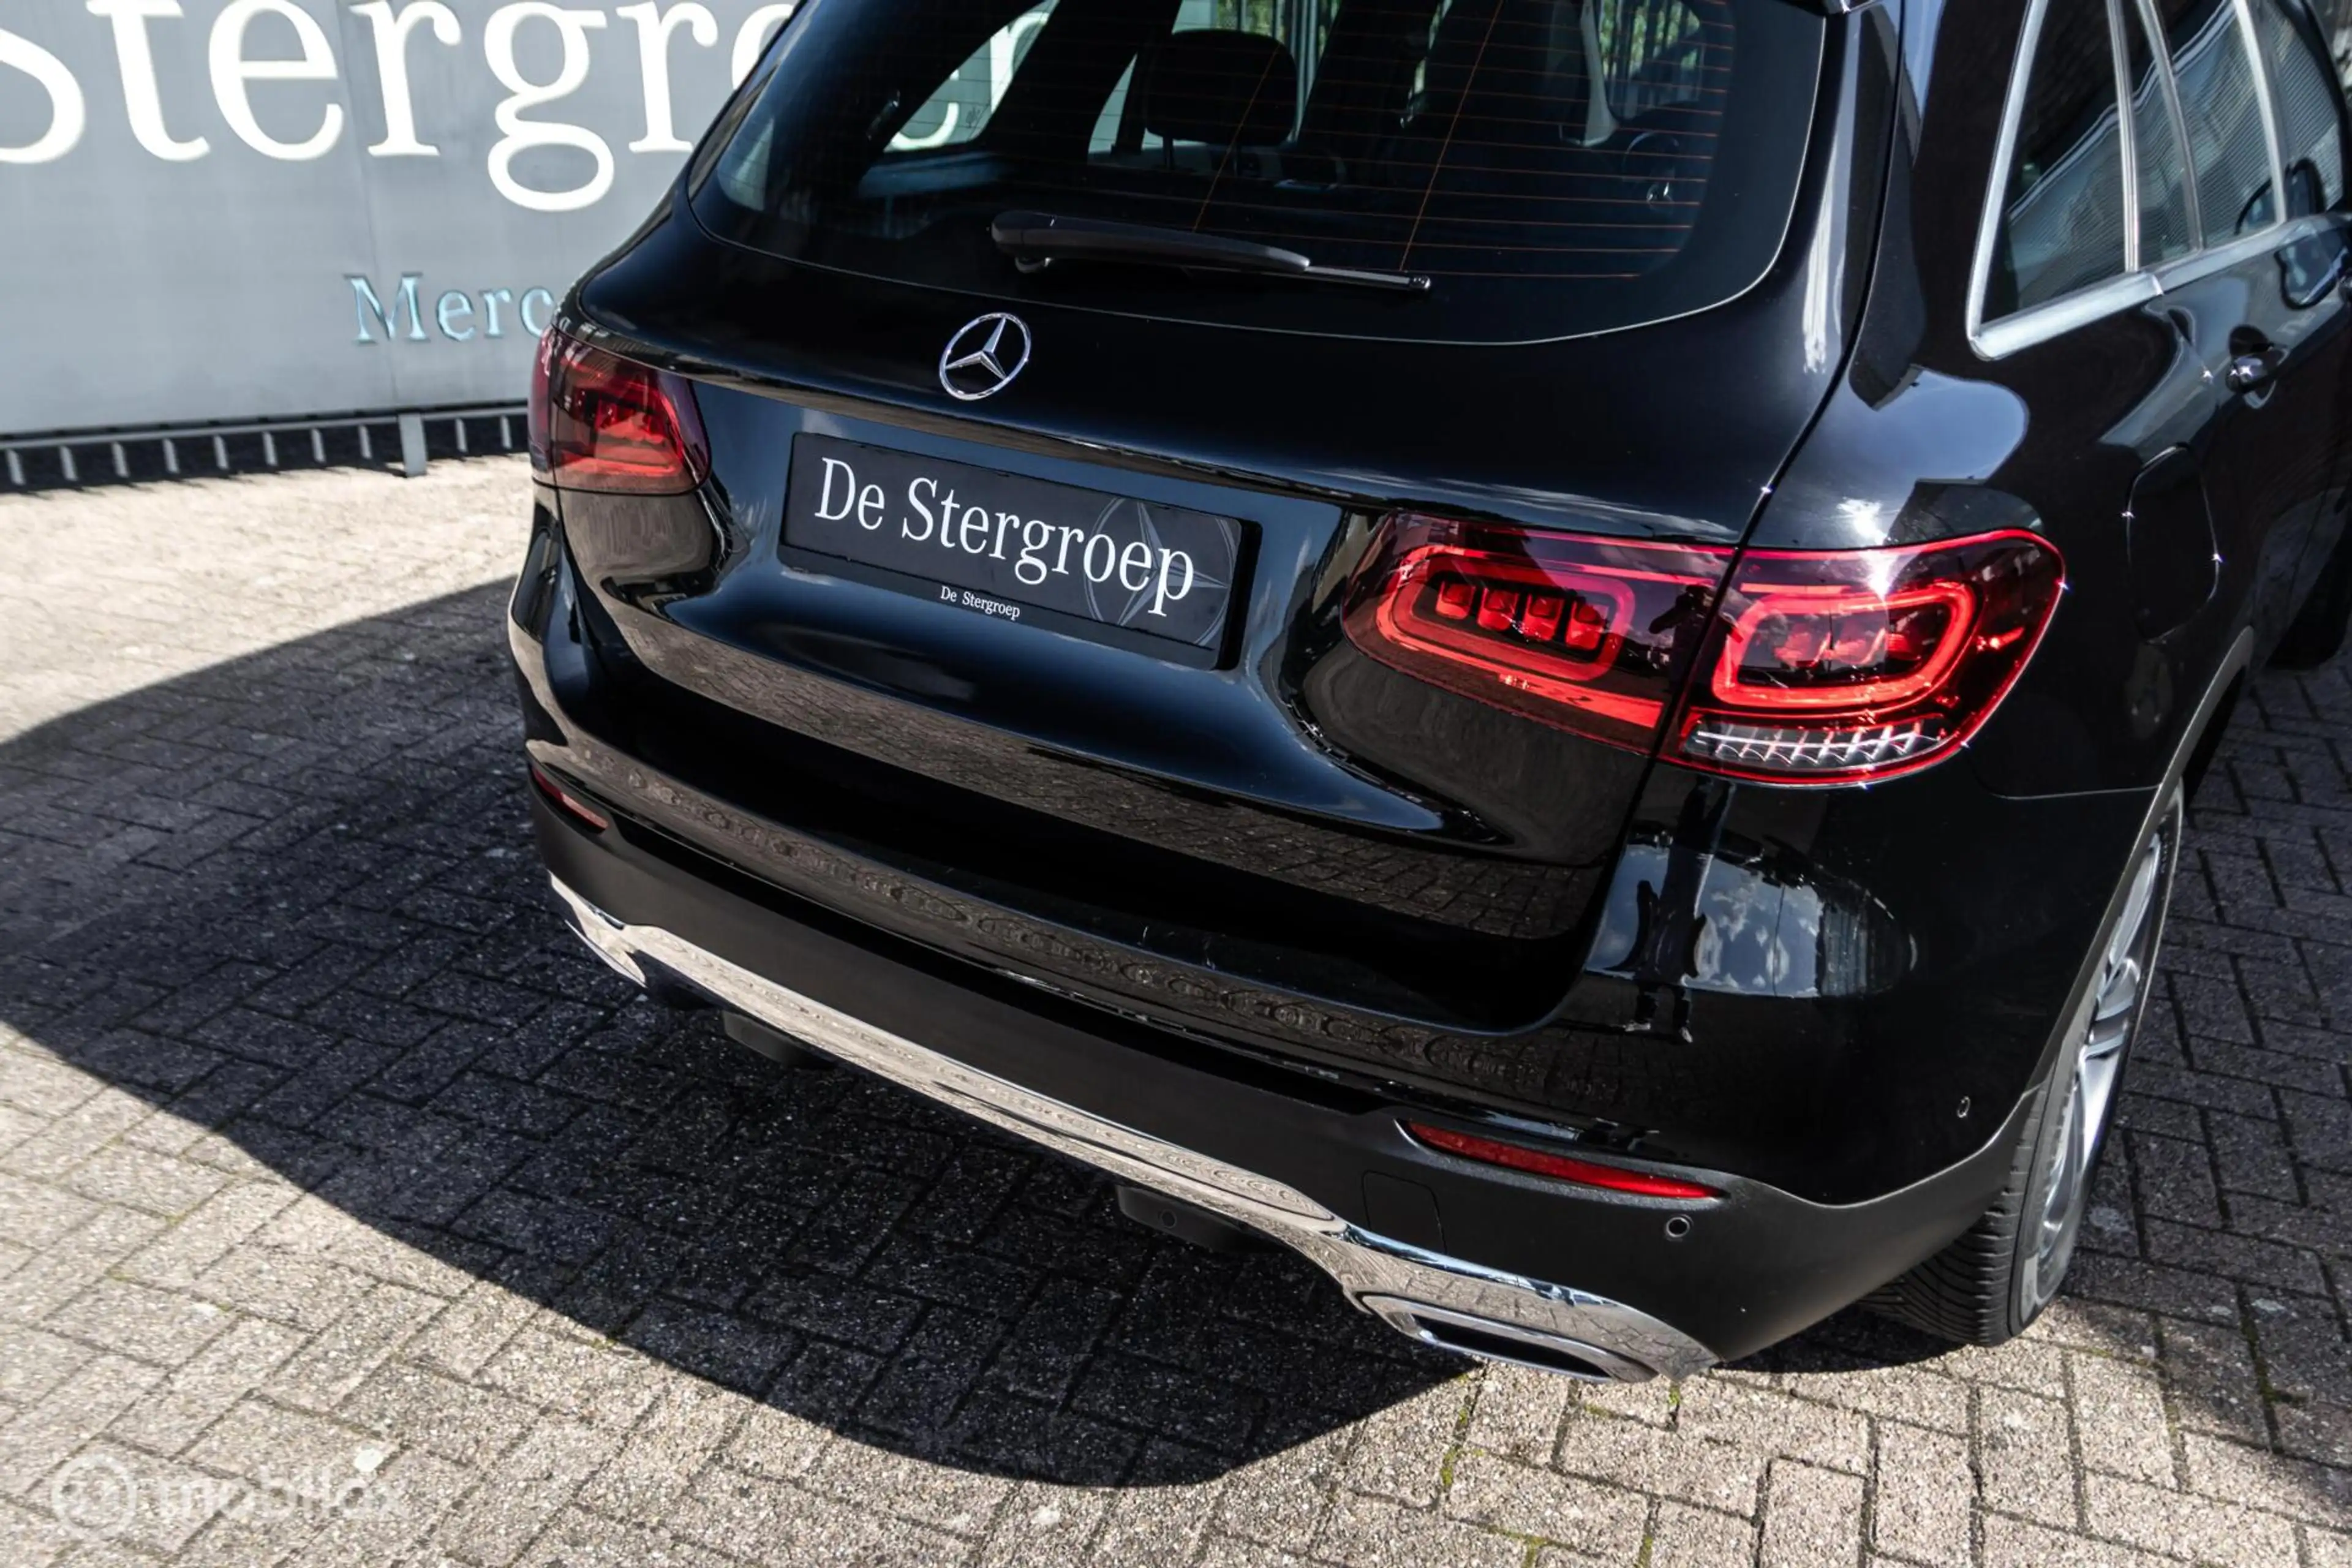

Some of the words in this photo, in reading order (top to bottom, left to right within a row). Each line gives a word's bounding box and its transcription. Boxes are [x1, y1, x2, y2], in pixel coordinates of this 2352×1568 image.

[814, 456, 886, 530] De
[901, 477, 1194, 617] Stergroep
[940, 585, 957, 603] De
[962, 590, 1020, 621] Stergroep
